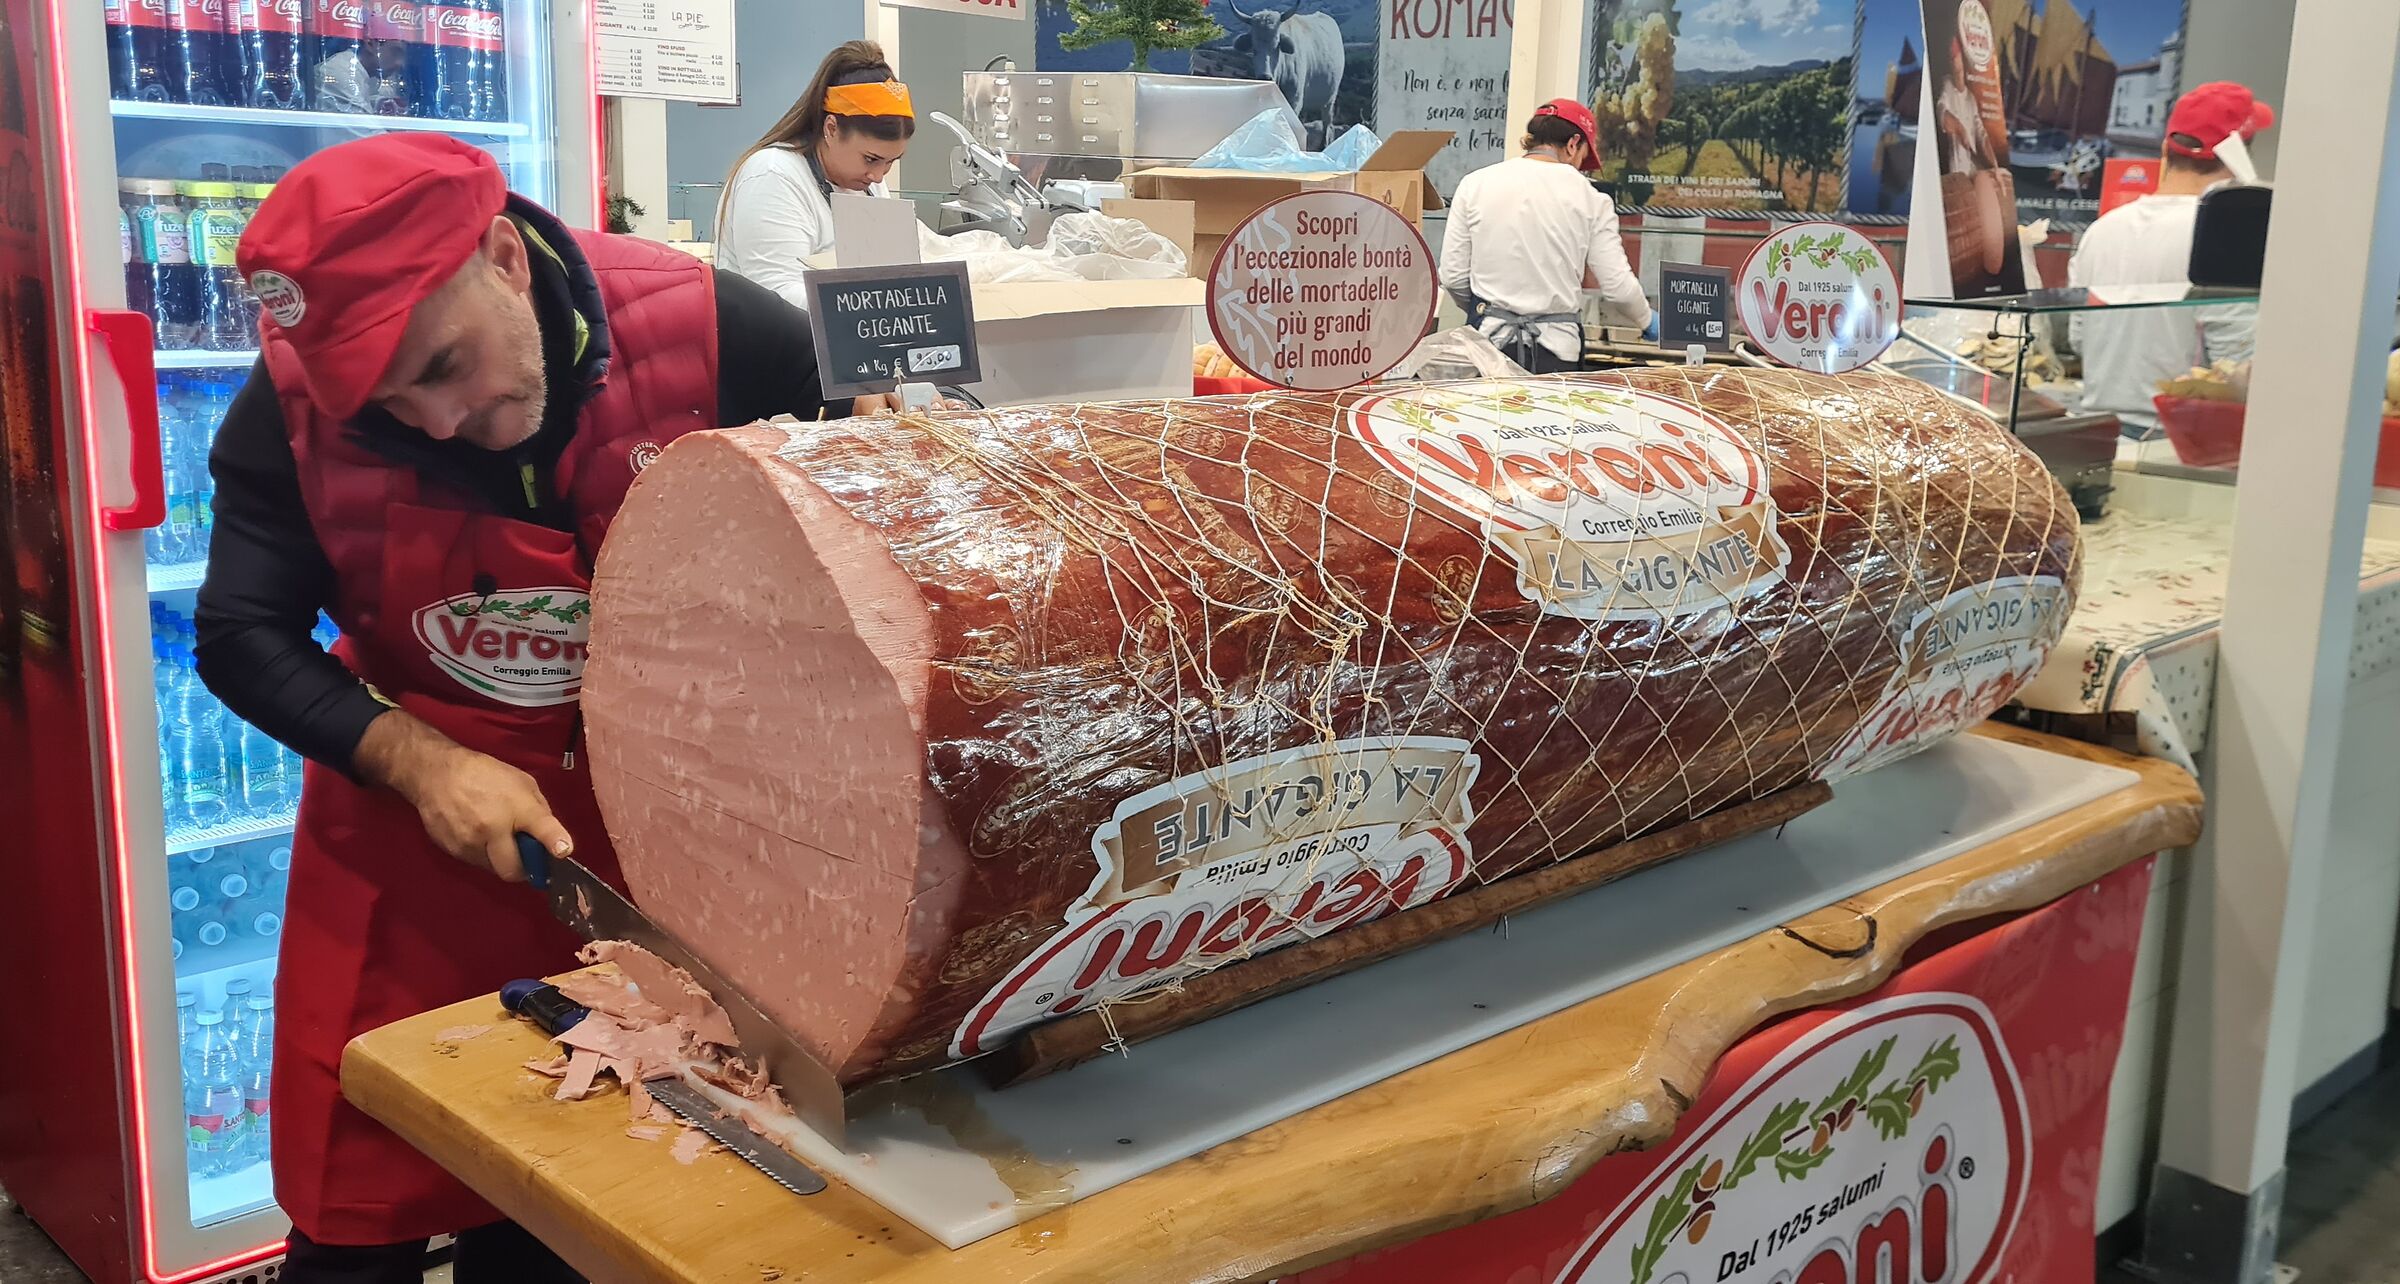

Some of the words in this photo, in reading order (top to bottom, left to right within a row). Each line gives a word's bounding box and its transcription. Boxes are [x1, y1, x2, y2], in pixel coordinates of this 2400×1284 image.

[1404, 69, 1429, 92] Non
[1454, 78, 1463, 90] e
[1469, 77, 1495, 92] non
[1426, 106, 1465, 121] senza
[1473, 105, 1507, 120] sacri
[1469, 129, 1479, 150] le
[1628, 175, 1662, 184] STRADA
[1664, 175, 1678, 185] DEI
[1680, 176, 1698, 185] VINI
[1709, 177, 1724, 186] DEI
[1726, 177, 1760, 187] SAPORI
[1695, 188, 1720, 198] COLLI
[1735, 190, 1784, 200] ROMAGNA
[2016, 198, 2052, 208] ANALE
[2070, 200, 2099, 210] CESE
[1296, 210, 1358, 242] Scopri
[1233, 243, 1357, 270] l'eccezionale
[1363, 243, 1412, 268] bontà
[836, 285, 947, 312] MORTADELLA
[1247, 278, 1294, 305] delle
[1301, 276, 1399, 303] mortadelle
[1670, 280, 1718, 296] MORTADELLA
[1798, 282, 1811, 292] Dal
[1813, 282, 1830, 292] 1925
[1832, 283, 1856, 293] salum
[1677, 299, 1711, 315] GIGANTE
[857, 314, 937, 339] GIGANTE
[1276, 311, 1307, 343] più
[1314, 307, 1371, 341] grandi
[1274, 343, 1304, 369] del
[1311, 340, 1372, 368] mondo
[1801, 348, 1834, 359] Correg
[857, 362, 868, 373] al
[874, 360, 888, 376] Kg
[1525, 423, 1565, 437] 1925
[1407, 423, 1732, 502] Veroni
[1582, 514, 1658, 536] Correggio
[1657, 509, 1704, 527] Emilia
[1548, 552, 1602, 592] LA
[1616, 531, 1757, 593] GIGANTE
[437, 614, 589, 660] Veron
[1926, 599, 2022, 658] GIGANTE
[493, 665, 539, 677] Correggio
[541, 667, 571, 676] Emilia
[1393, 766, 1445, 806] LA
[1154, 769, 1372, 865] GIGANTE
[1277, 833, 1370, 869] Correggio
[1052, 855, 1426, 1013] Veroni
[1716, 1238, 1759, 1283] Dal
[1765, 1205, 1815, 1258] 1925
[1815, 1162, 1888, 1227] salumi
